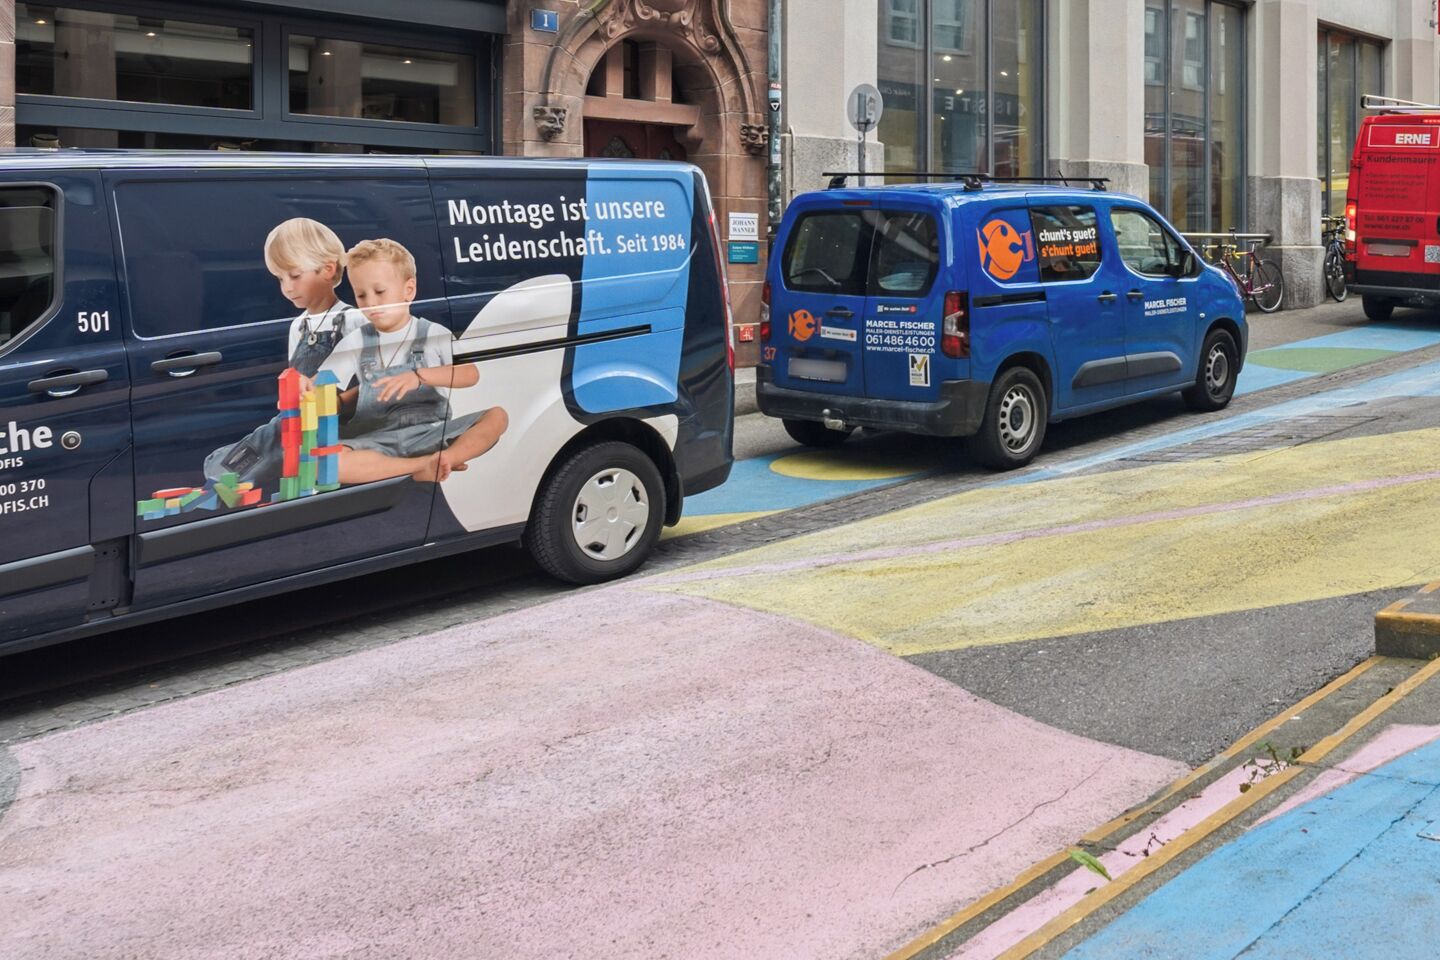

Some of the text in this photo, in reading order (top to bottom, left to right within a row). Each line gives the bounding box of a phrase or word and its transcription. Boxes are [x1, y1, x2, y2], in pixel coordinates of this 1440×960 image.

[543, 14, 549, 27] 1
[1395, 133, 1431, 145] ERNE
[1367, 155, 1436, 164] Kundenmaurer
[448, 196, 665, 229] Montage ist unsere
[1039, 227, 1096, 242] chunt's guet?
[454, 229, 686, 264] Leidenschaft. Seit 1984
[1041, 242, 1097, 257] s'chunt guet!
[1144, 297, 1187, 310] MARCEL FISCHER
[77, 311, 110, 333] 501
[866, 320, 935, 330] MARCEL FISCHER
[866, 334, 935, 347] 061 486 46 00
[764, 346, 776, 361] 37
[866, 345, 936, 354] www.marcel-fischer.ch
[20, 478, 46, 493] 370
